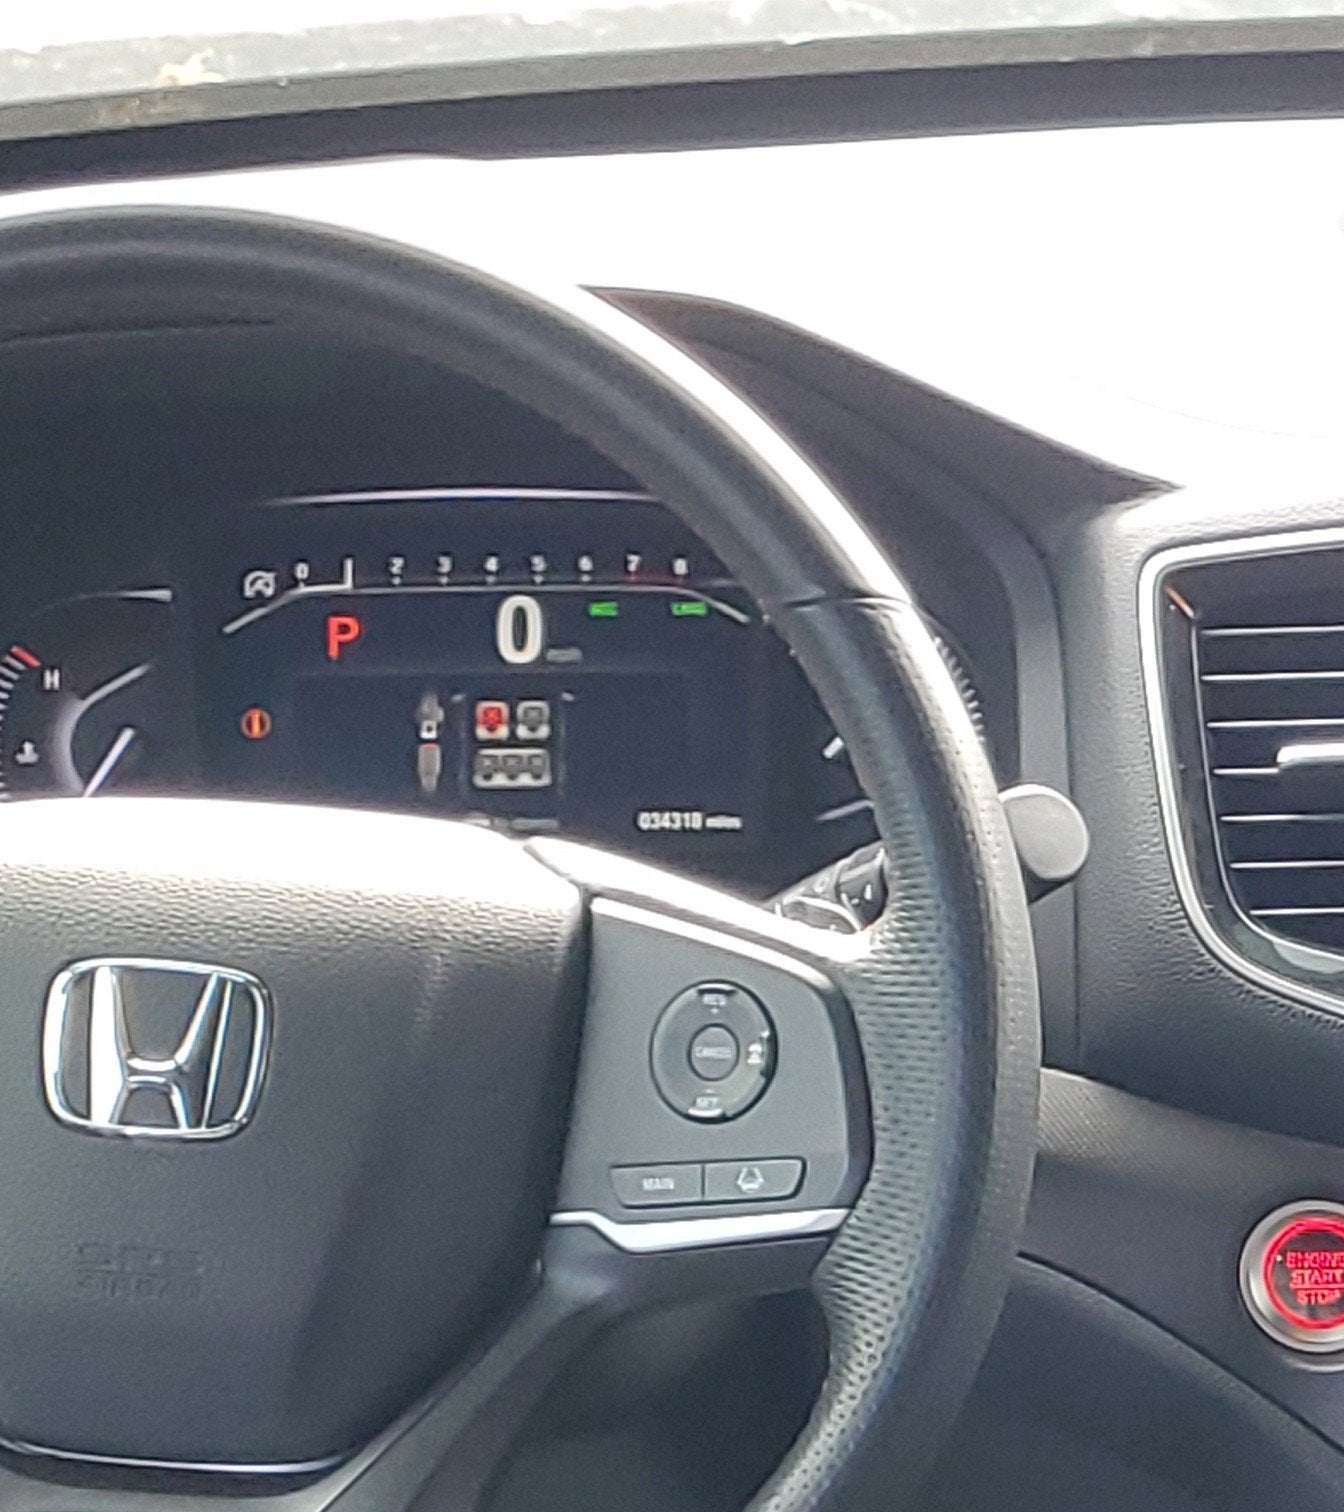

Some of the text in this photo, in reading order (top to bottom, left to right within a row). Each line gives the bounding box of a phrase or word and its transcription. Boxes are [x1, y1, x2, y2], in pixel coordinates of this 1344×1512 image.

[388, 556, 404, 575] 2
[436, 555, 452, 574] 3
[484, 556, 499, 573] 4
[626, 554, 642, 573] 7
[326, 614, 361, 660] P
[496, 594, 543, 665] 0
[42, 668, 61, 691] H
[1297, 1289, 1341, 1304] STOP
